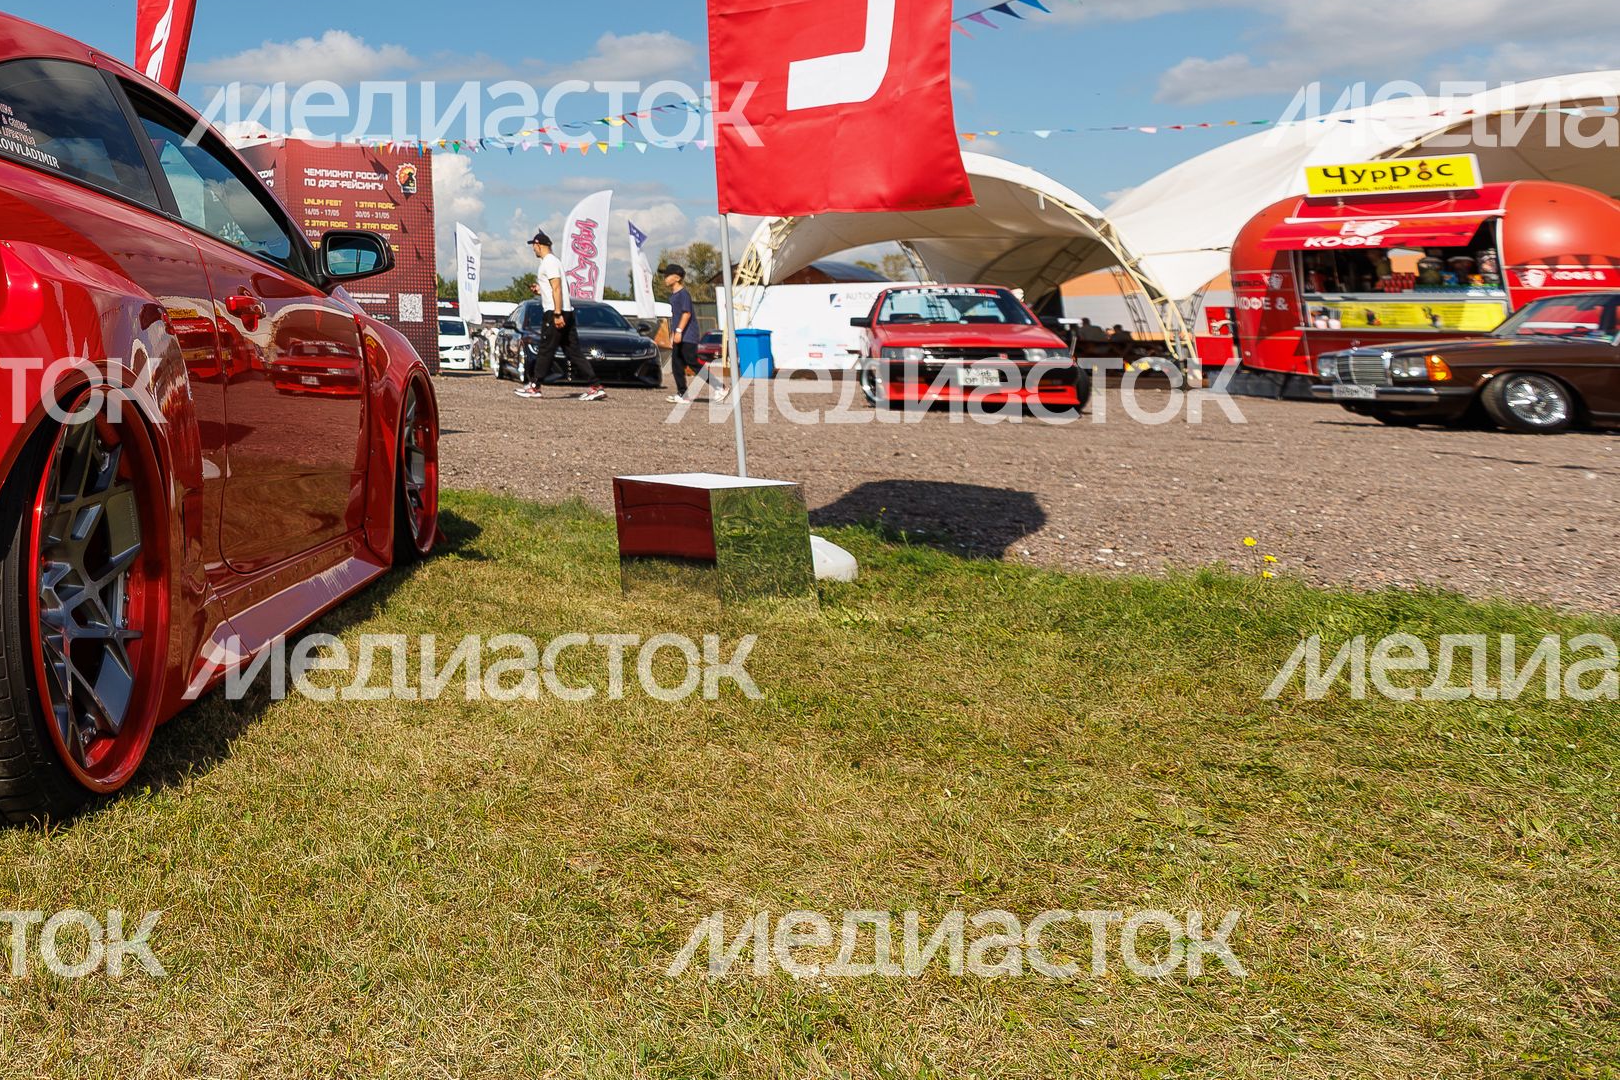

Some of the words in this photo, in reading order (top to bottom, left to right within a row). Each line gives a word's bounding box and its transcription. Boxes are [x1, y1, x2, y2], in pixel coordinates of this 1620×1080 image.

[304, 168, 353, 178] ЧЕМПИОНАТ
[356, 172, 388, 181] РОССИИ
[304, 178, 316, 186] ПО
[1303, 235, 1383, 247] КОФЕ
[466, 255, 476, 281] ВТБ
